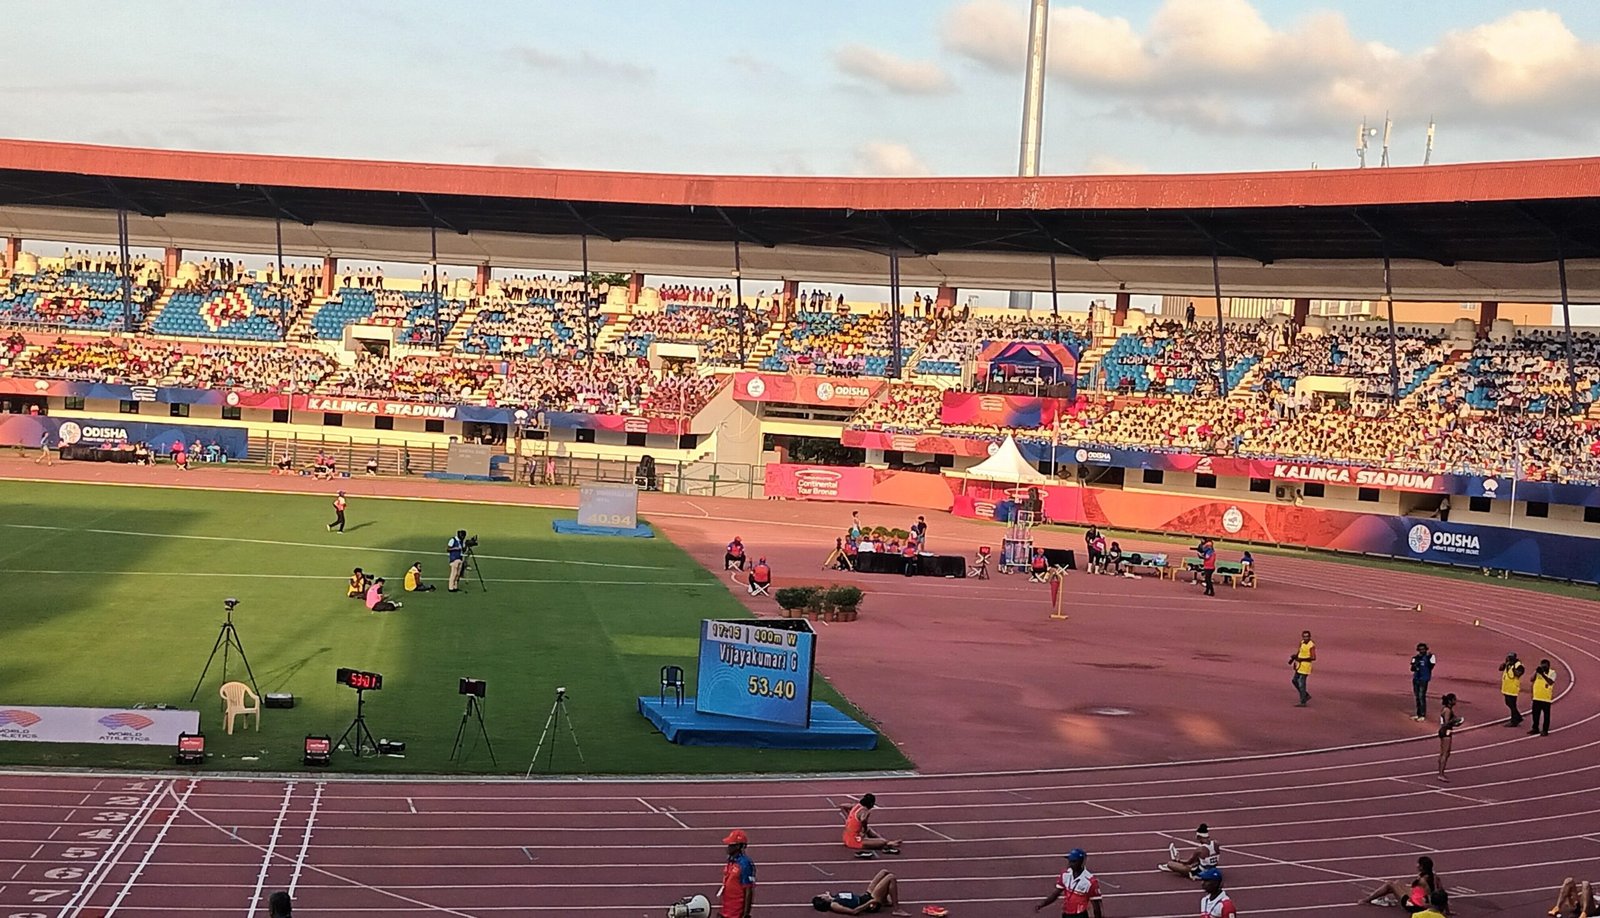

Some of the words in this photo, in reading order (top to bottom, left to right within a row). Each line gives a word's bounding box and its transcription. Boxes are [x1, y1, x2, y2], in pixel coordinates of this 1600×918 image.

[835, 386, 870, 396] ODISHA
[308, 398, 379, 414] KALINGA
[384, 403, 457, 419] STADIUM
[82, 426, 128, 439] ODISHA
[1274, 464, 1350, 483] KALINGA
[1356, 470, 1434, 489] STADIUM
[798, 480, 838, 488] Continental
[1433, 531, 1480, 549] ODISHA
[712, 623, 741, 640] 17:15
[754, 628, 783, 646] 400m
[787, 632, 797, 646] W
[719, 643, 787, 671] Vijayakumari
[791, 652, 798, 672] G
[749, 675, 796, 700] 53.40
[105, 796, 141, 805] 2
[92, 811, 130, 821] 3
[78, 828, 114, 839] 4
[61, 847, 100, 858] 5
[44, 867, 85, 879] 6
[28, 889, 71, 902] 7
